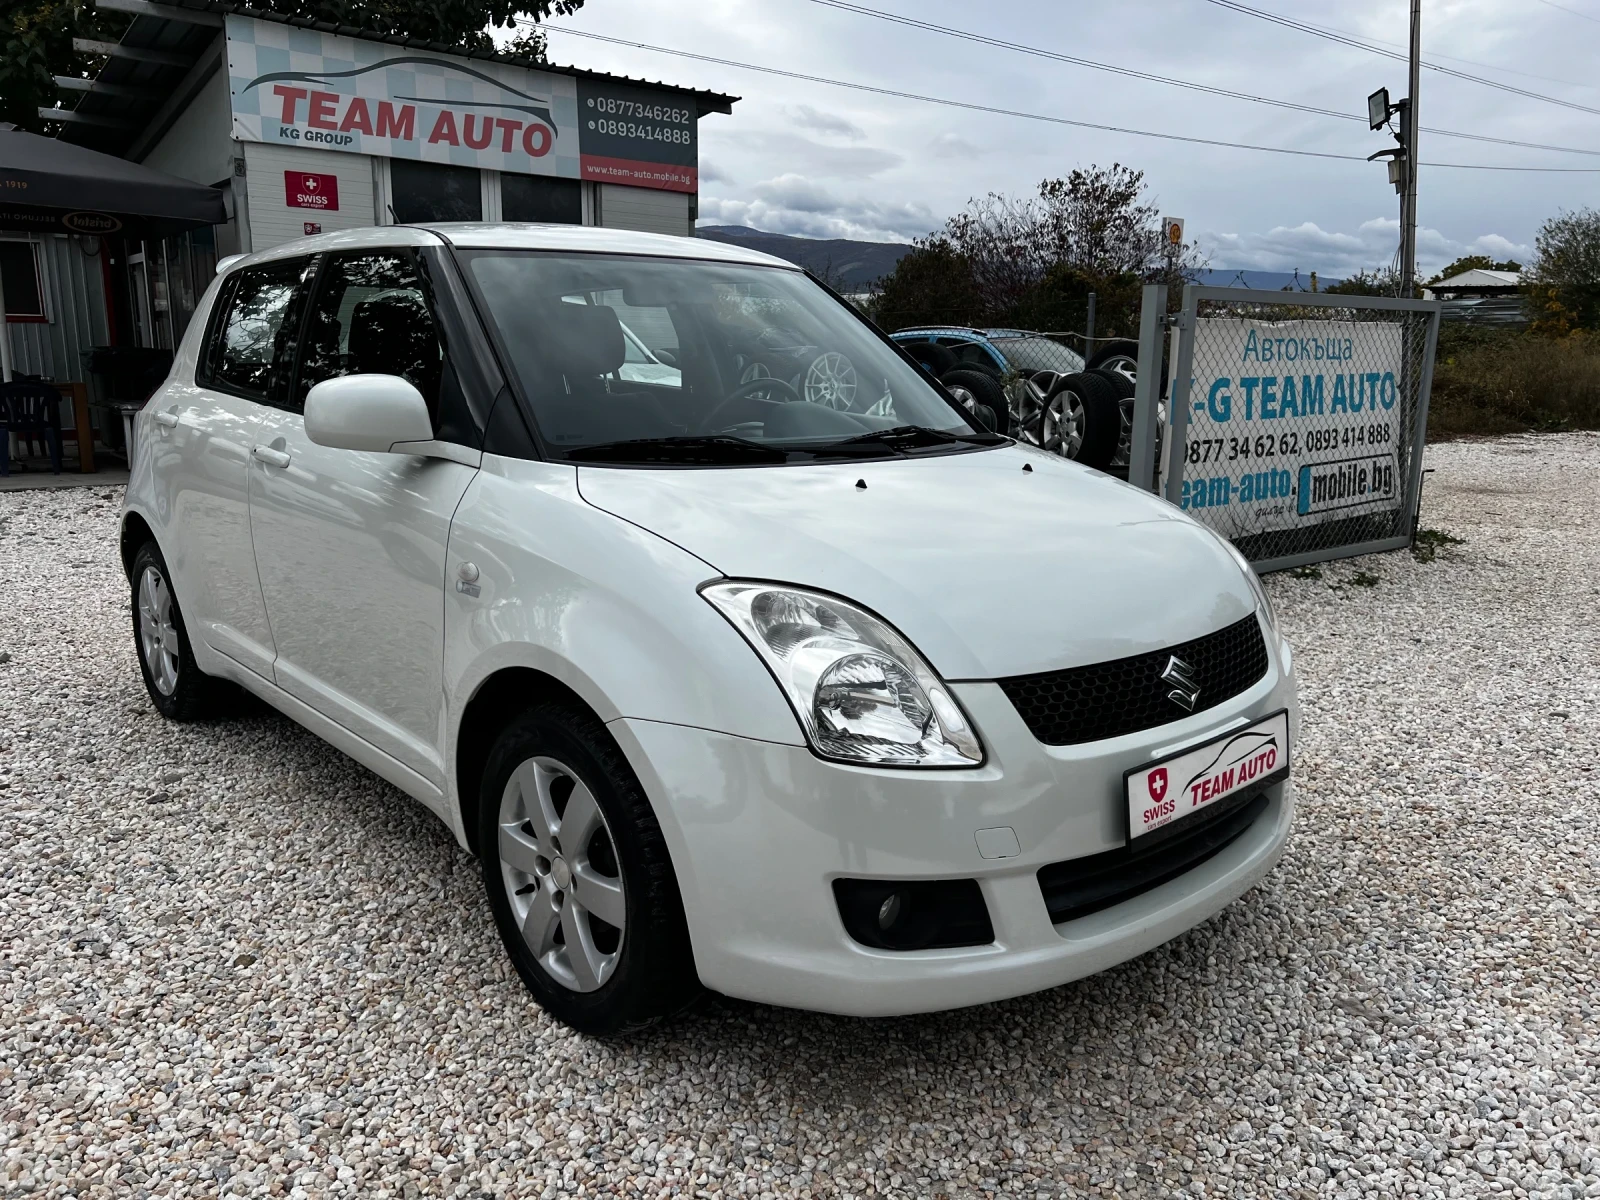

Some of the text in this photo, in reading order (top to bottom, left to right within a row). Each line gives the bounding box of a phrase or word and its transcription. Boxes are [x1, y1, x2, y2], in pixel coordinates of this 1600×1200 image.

[273, 84, 552, 158] TEAM AUTO
[597, 97, 690, 124] 0877346262
[280, 126, 353, 146] KG GROUP
[598, 119, 691, 145] 0893414888
[5, 180, 28, 189] 1919
[587, 165, 691, 185] www.team-auto.mobile.bg
[297, 193, 328, 205] SWISS
[1243, 329, 1353, 366] Автокъща
[1240, 374, 1324, 421] TEAM
[1331, 371, 1396, 415] AUTO
[1184, 423, 1390, 465] 877 34 62 62, 0893 414 888
[1312, 460, 1392, 503] mobile.bg
[1191, 748, 1276, 806] TEAM AUTO
[1143, 799, 1175, 824] SWISS
